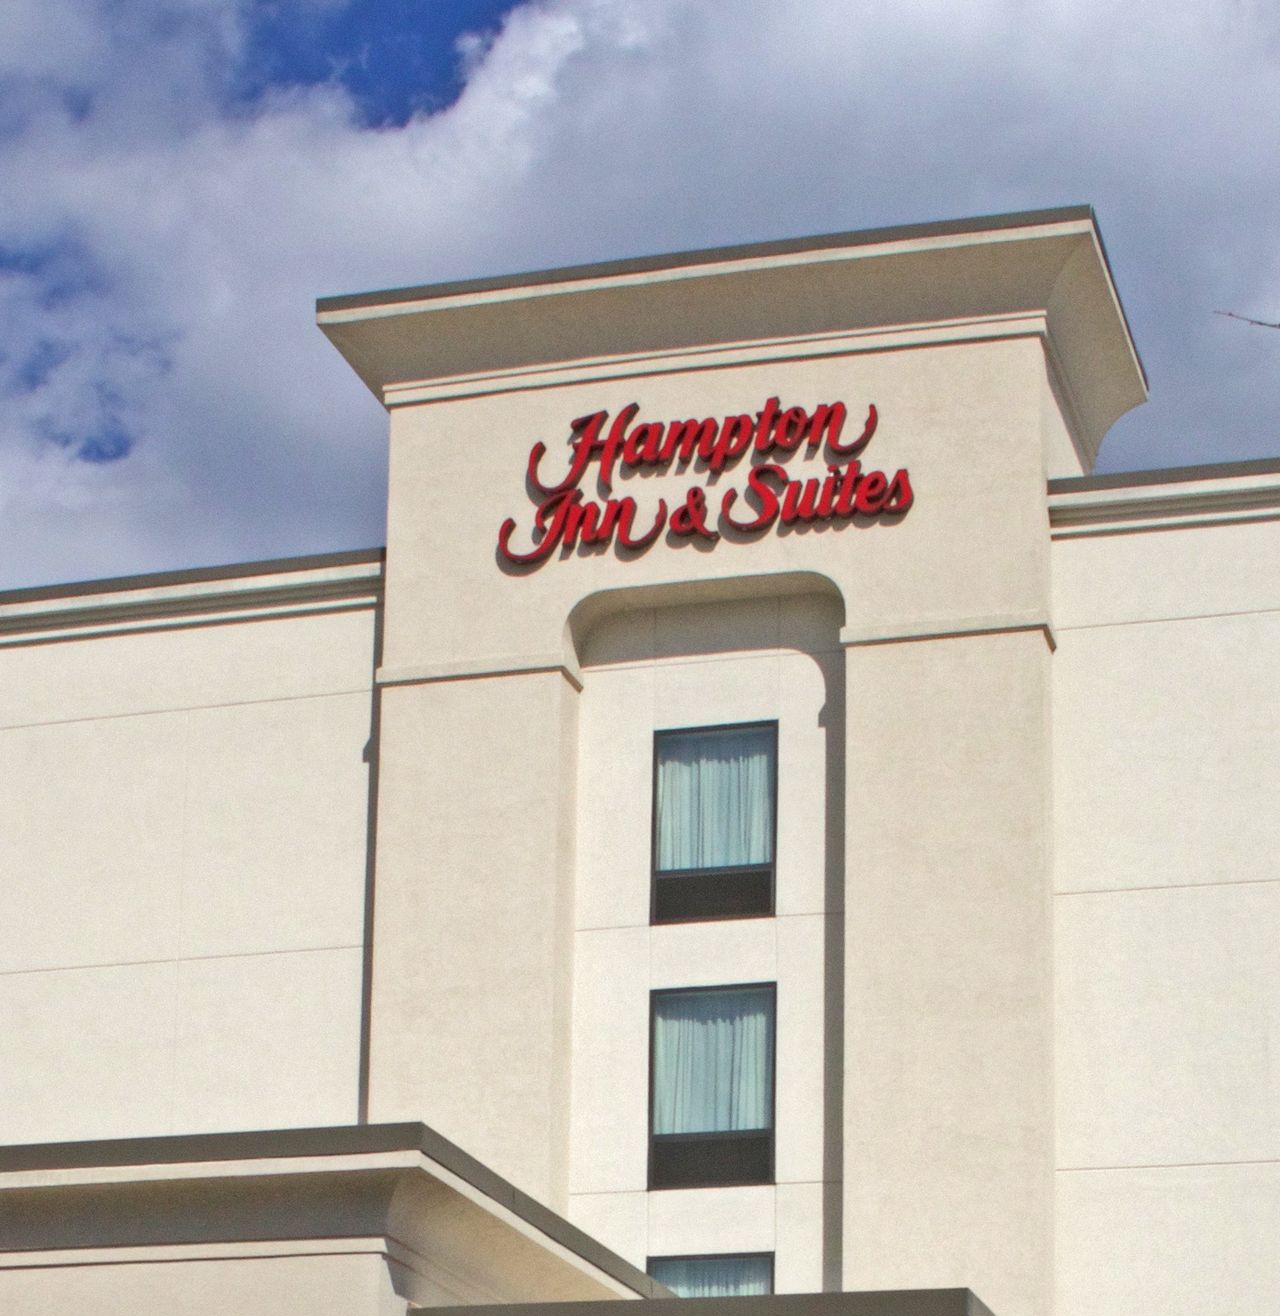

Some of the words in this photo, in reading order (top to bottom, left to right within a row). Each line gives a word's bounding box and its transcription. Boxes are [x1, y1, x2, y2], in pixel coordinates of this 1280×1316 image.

[528, 396, 878, 495] Hampton
[498, 490, 667, 564] Inn
[669, 486, 720, 541] &
[721, 460, 914, 531] Suites
